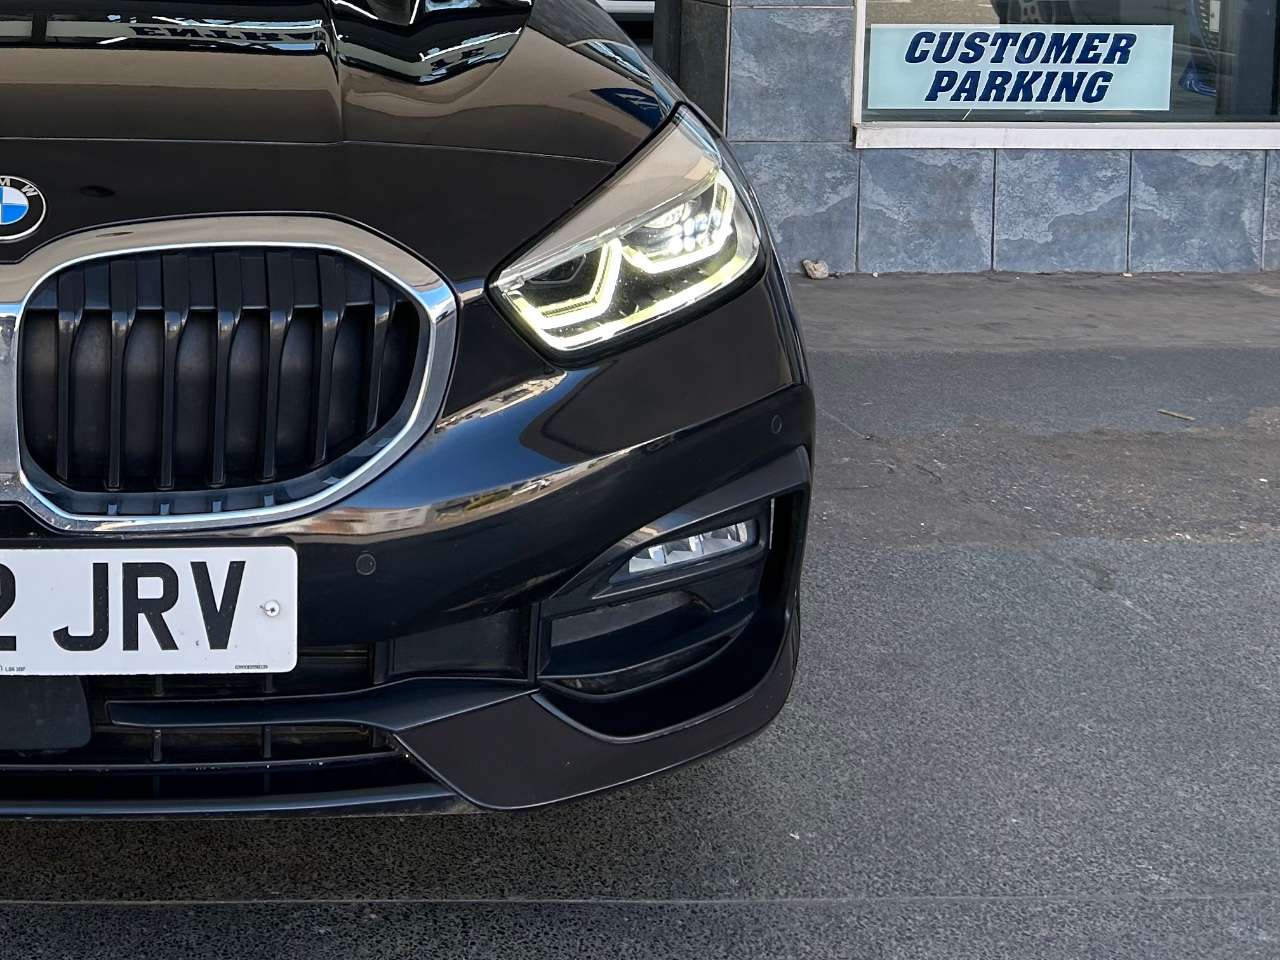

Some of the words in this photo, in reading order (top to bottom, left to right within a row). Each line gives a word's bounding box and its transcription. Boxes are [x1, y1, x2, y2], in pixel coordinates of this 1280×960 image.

[904, 31, 1137, 65] CUSTOMER
[924, 70, 1113, 103] PARKING
[52, 561, 246, 652] JRV
